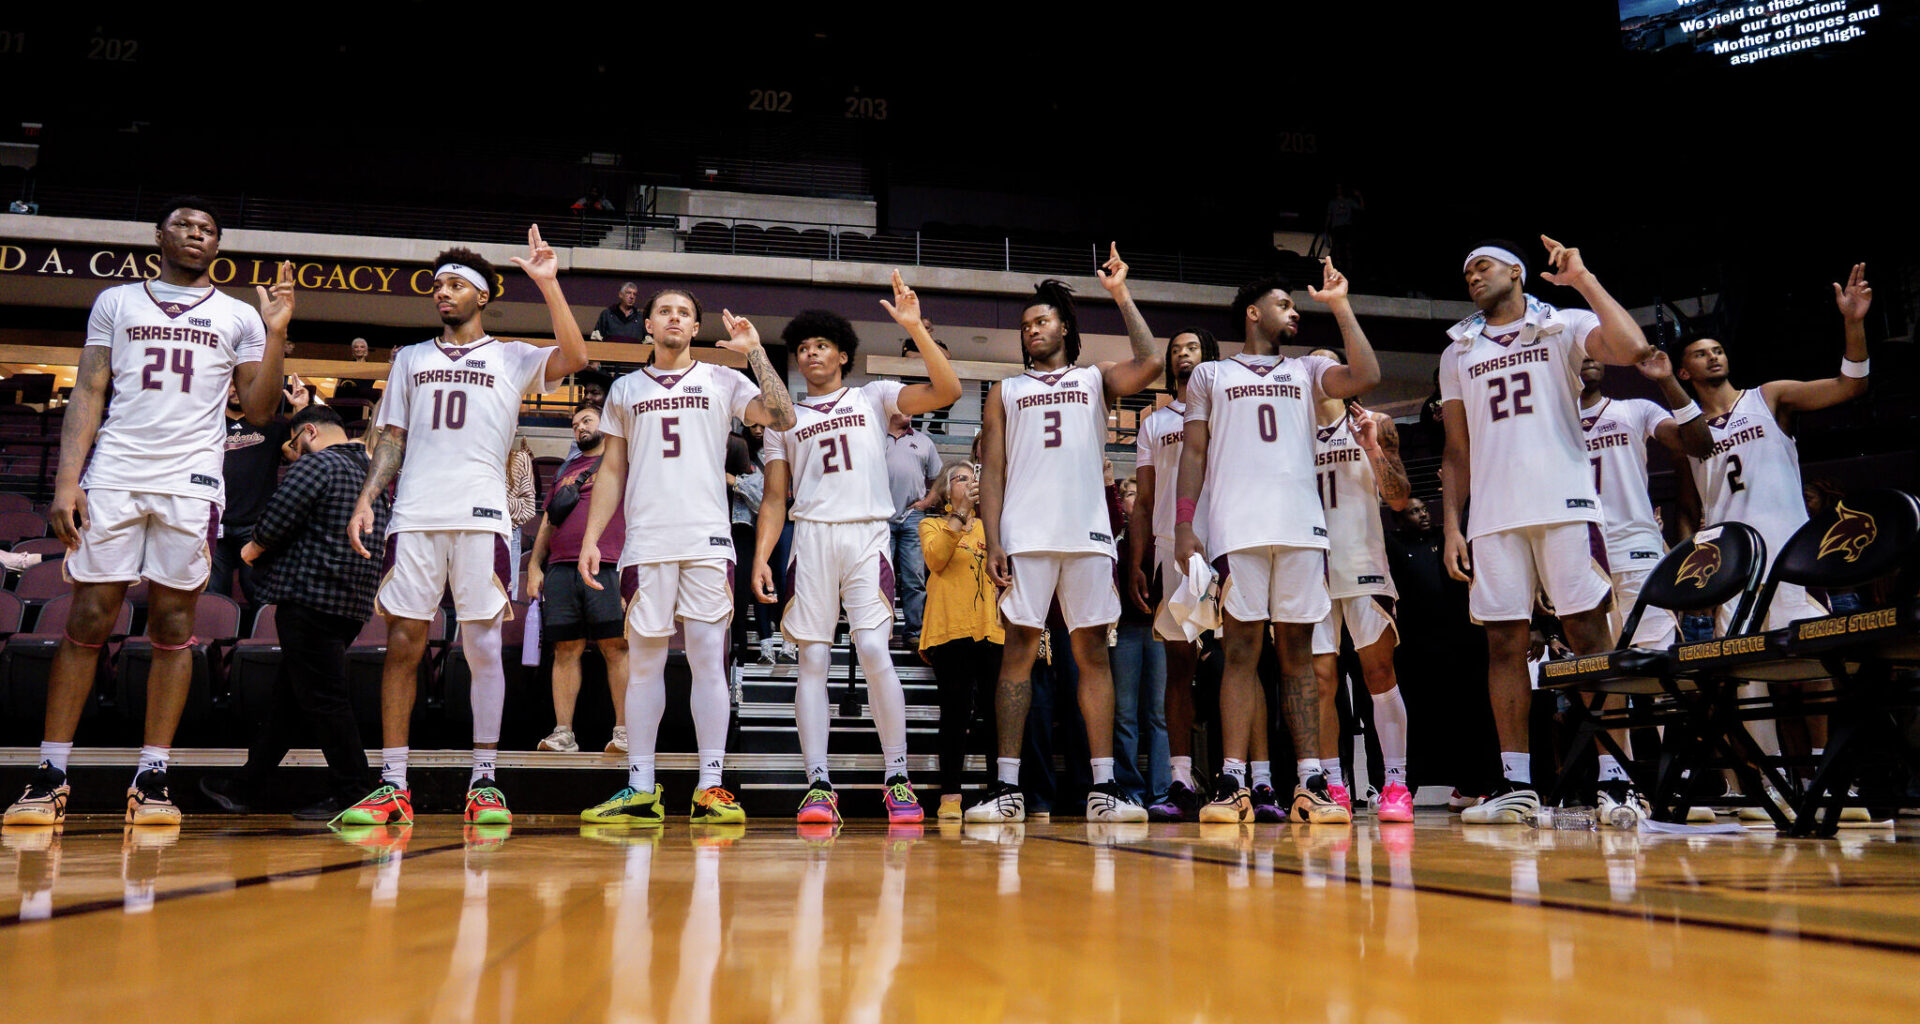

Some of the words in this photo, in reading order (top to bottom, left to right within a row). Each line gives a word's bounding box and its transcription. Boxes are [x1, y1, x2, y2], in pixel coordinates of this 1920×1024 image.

[1680, 19, 1705, 33] We
[1707, 8, 1745, 29] yield
[1747, 5, 1765, 17] to
[1713, 32, 1771, 55] Mother
[1775, 25, 1792, 40] of
[1794, 15, 1845, 36] hopes
[1848, 4, 1880, 23] and
[1741, 19, 1768, 33] our
[1771, 0, 1847, 26] devotion;
[88, 36, 139, 62] 202
[1730, 36, 1821, 66] aspirations
[1824, 25, 1866, 43] high.
[748, 88, 793, 112] 202
[843, 96, 889, 120] 203
[37, 248, 74, 275] A.
[249, 259, 399, 292] LEGACY
[142, 347, 194, 393] 24
[432, 389, 467, 430] 10
[1487, 371, 1534, 422] 22
[661, 416, 681, 458] 5
[1044, 410, 1062, 449] 3
[1258, 403, 1277, 442] 0
[819, 434, 853, 474] 21
[1727, 454, 1745, 495] 2
[1799, 616, 1847, 640] TEXAS
[1848, 608, 1896, 632] STATE
[1679, 641, 1721, 661] TEXAS
[1722, 635, 1766, 655] STATE
